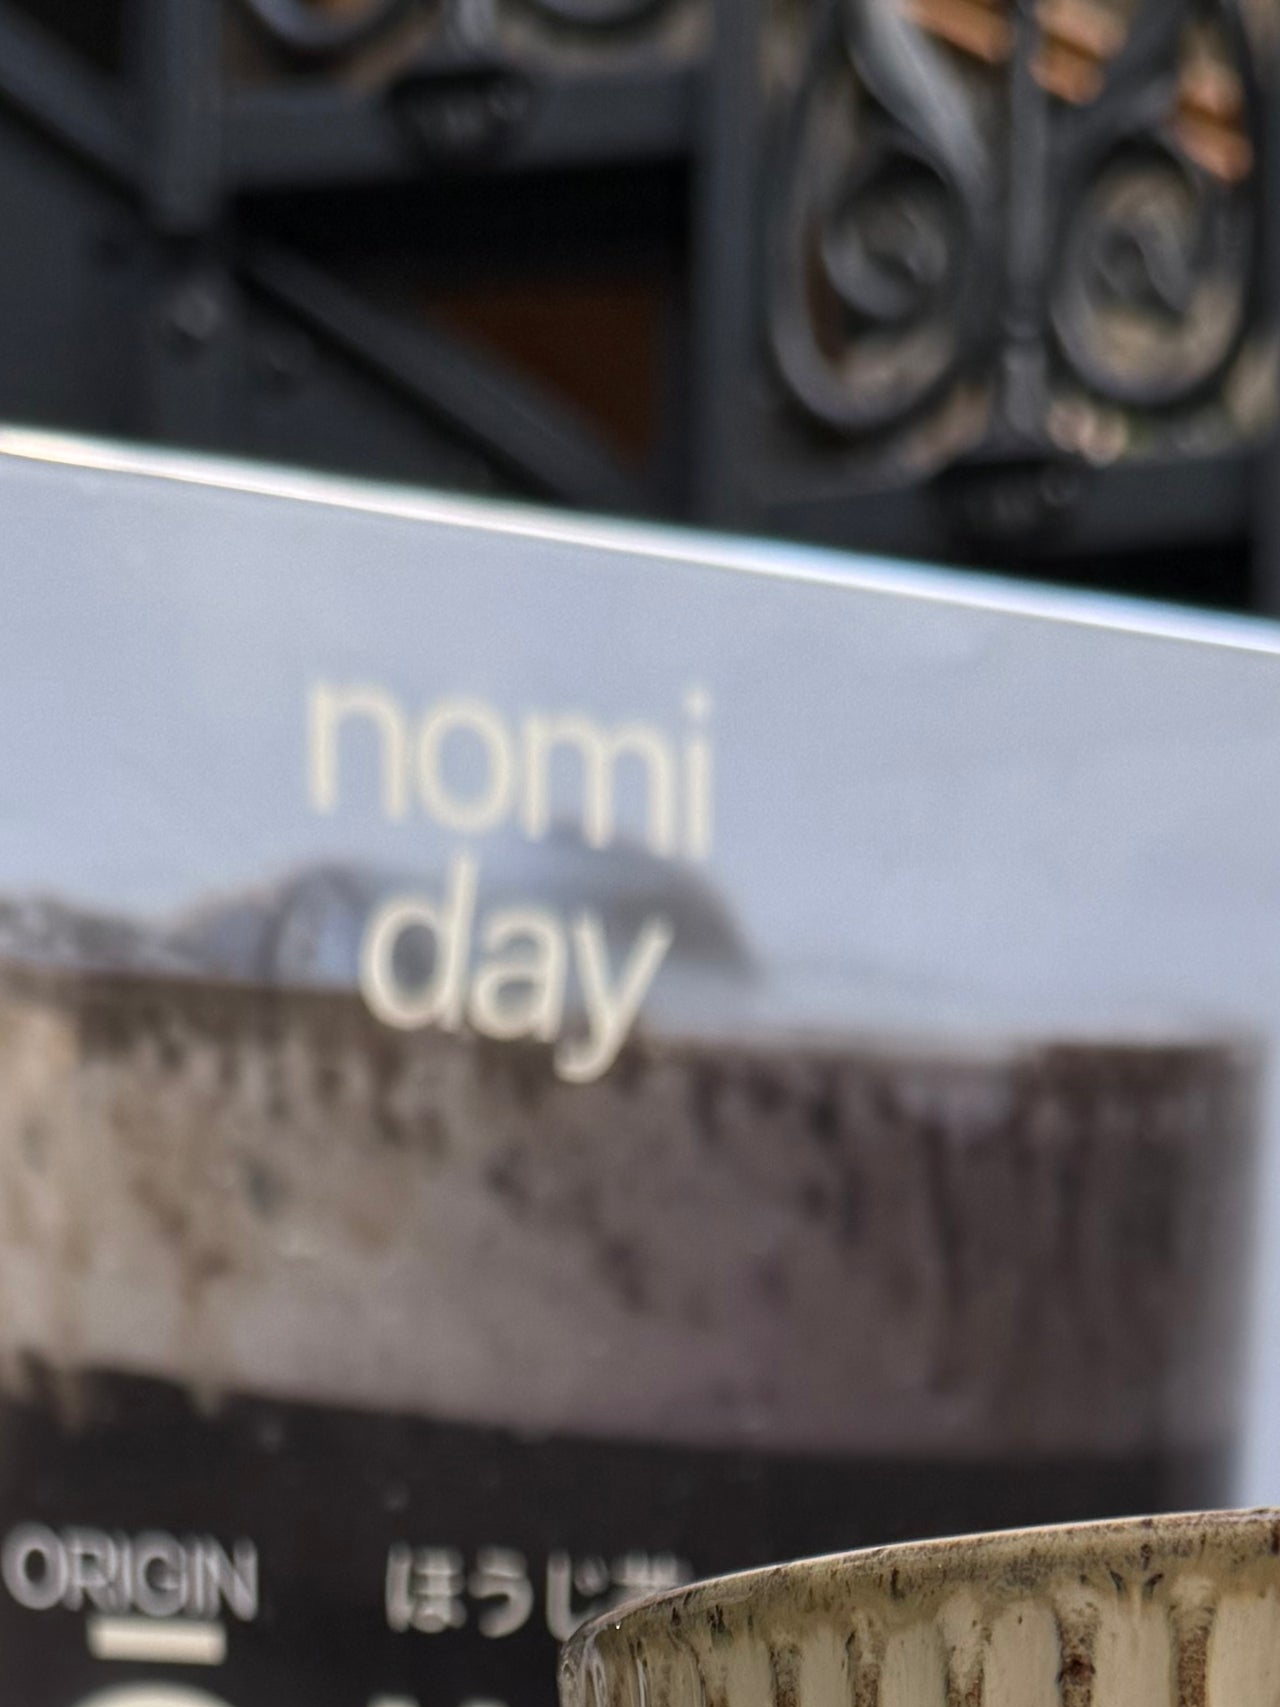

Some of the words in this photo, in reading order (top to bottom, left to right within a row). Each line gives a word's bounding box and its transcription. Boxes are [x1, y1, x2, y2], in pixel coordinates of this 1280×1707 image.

[308, 682, 713, 860] nomi
[358, 852, 675, 1084] day
[2, 1520, 259, 1622] ORIGIN
